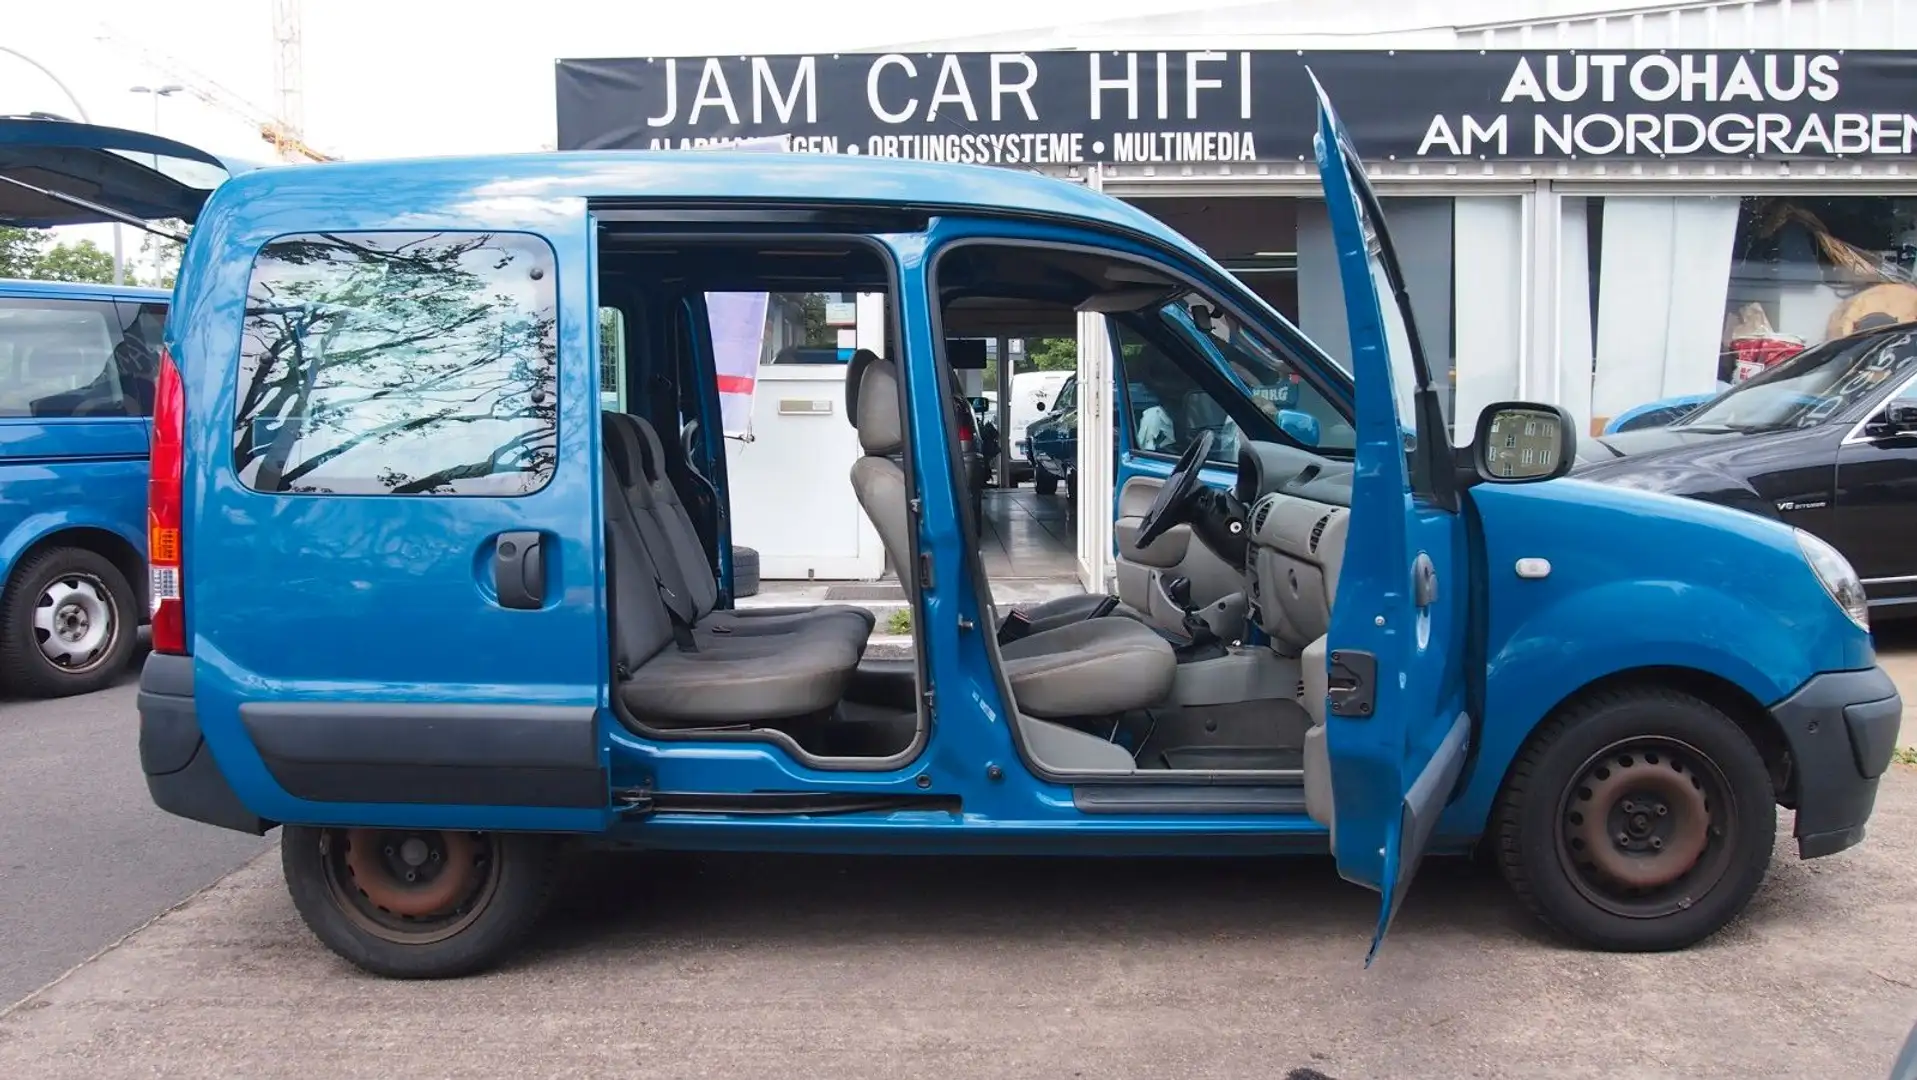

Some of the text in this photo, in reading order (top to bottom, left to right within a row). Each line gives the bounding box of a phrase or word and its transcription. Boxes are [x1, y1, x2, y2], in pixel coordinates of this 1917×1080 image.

[647, 52, 1251, 127] JAM CAR HIFI
[1501, 55, 1839, 102] AUTOHAUS
[868, 133, 1084, 163] ORTUNGSSYSTEME
[1113, 132, 1256, 162] MULTIMEDIA
[1417, 114, 1507, 155] AM
